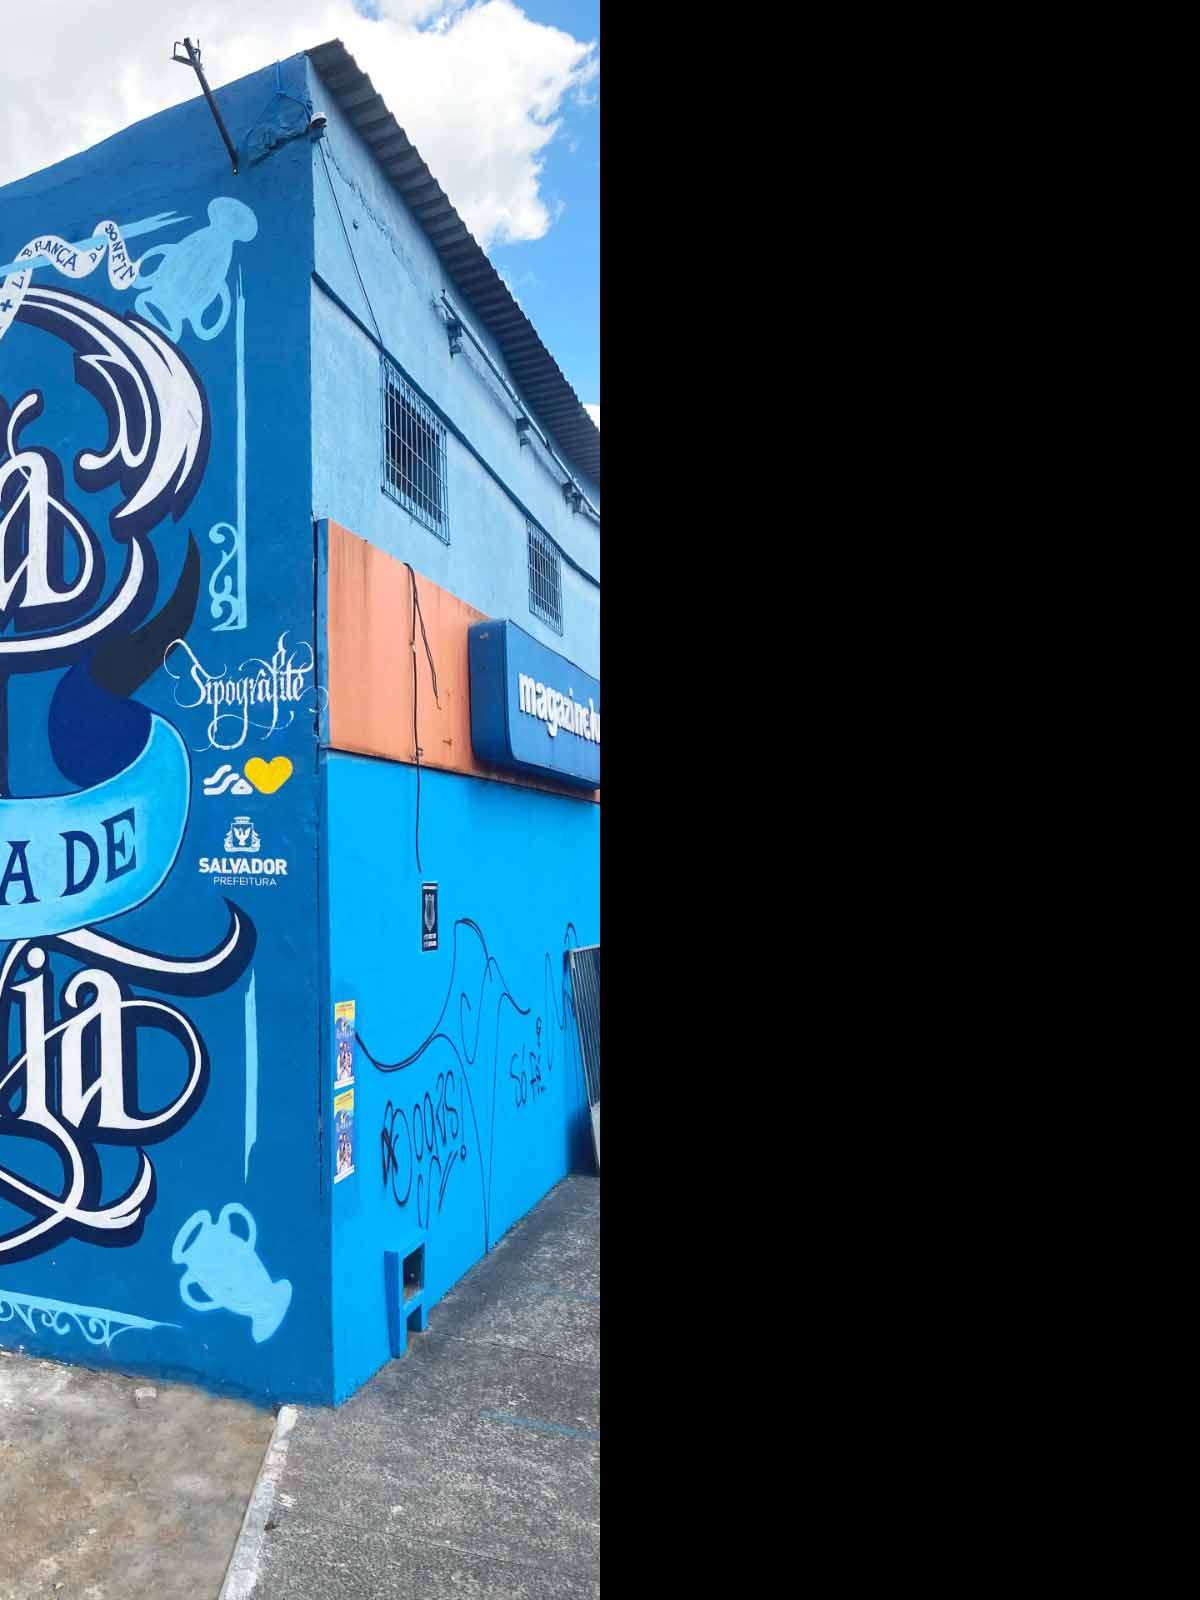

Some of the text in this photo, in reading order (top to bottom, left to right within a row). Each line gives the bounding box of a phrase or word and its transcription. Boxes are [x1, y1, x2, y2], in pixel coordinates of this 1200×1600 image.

[58, 807, 137, 898] DE
[198, 857, 288, 876] SALVADOR
[212, 876, 278, 887] PREFEITURA
